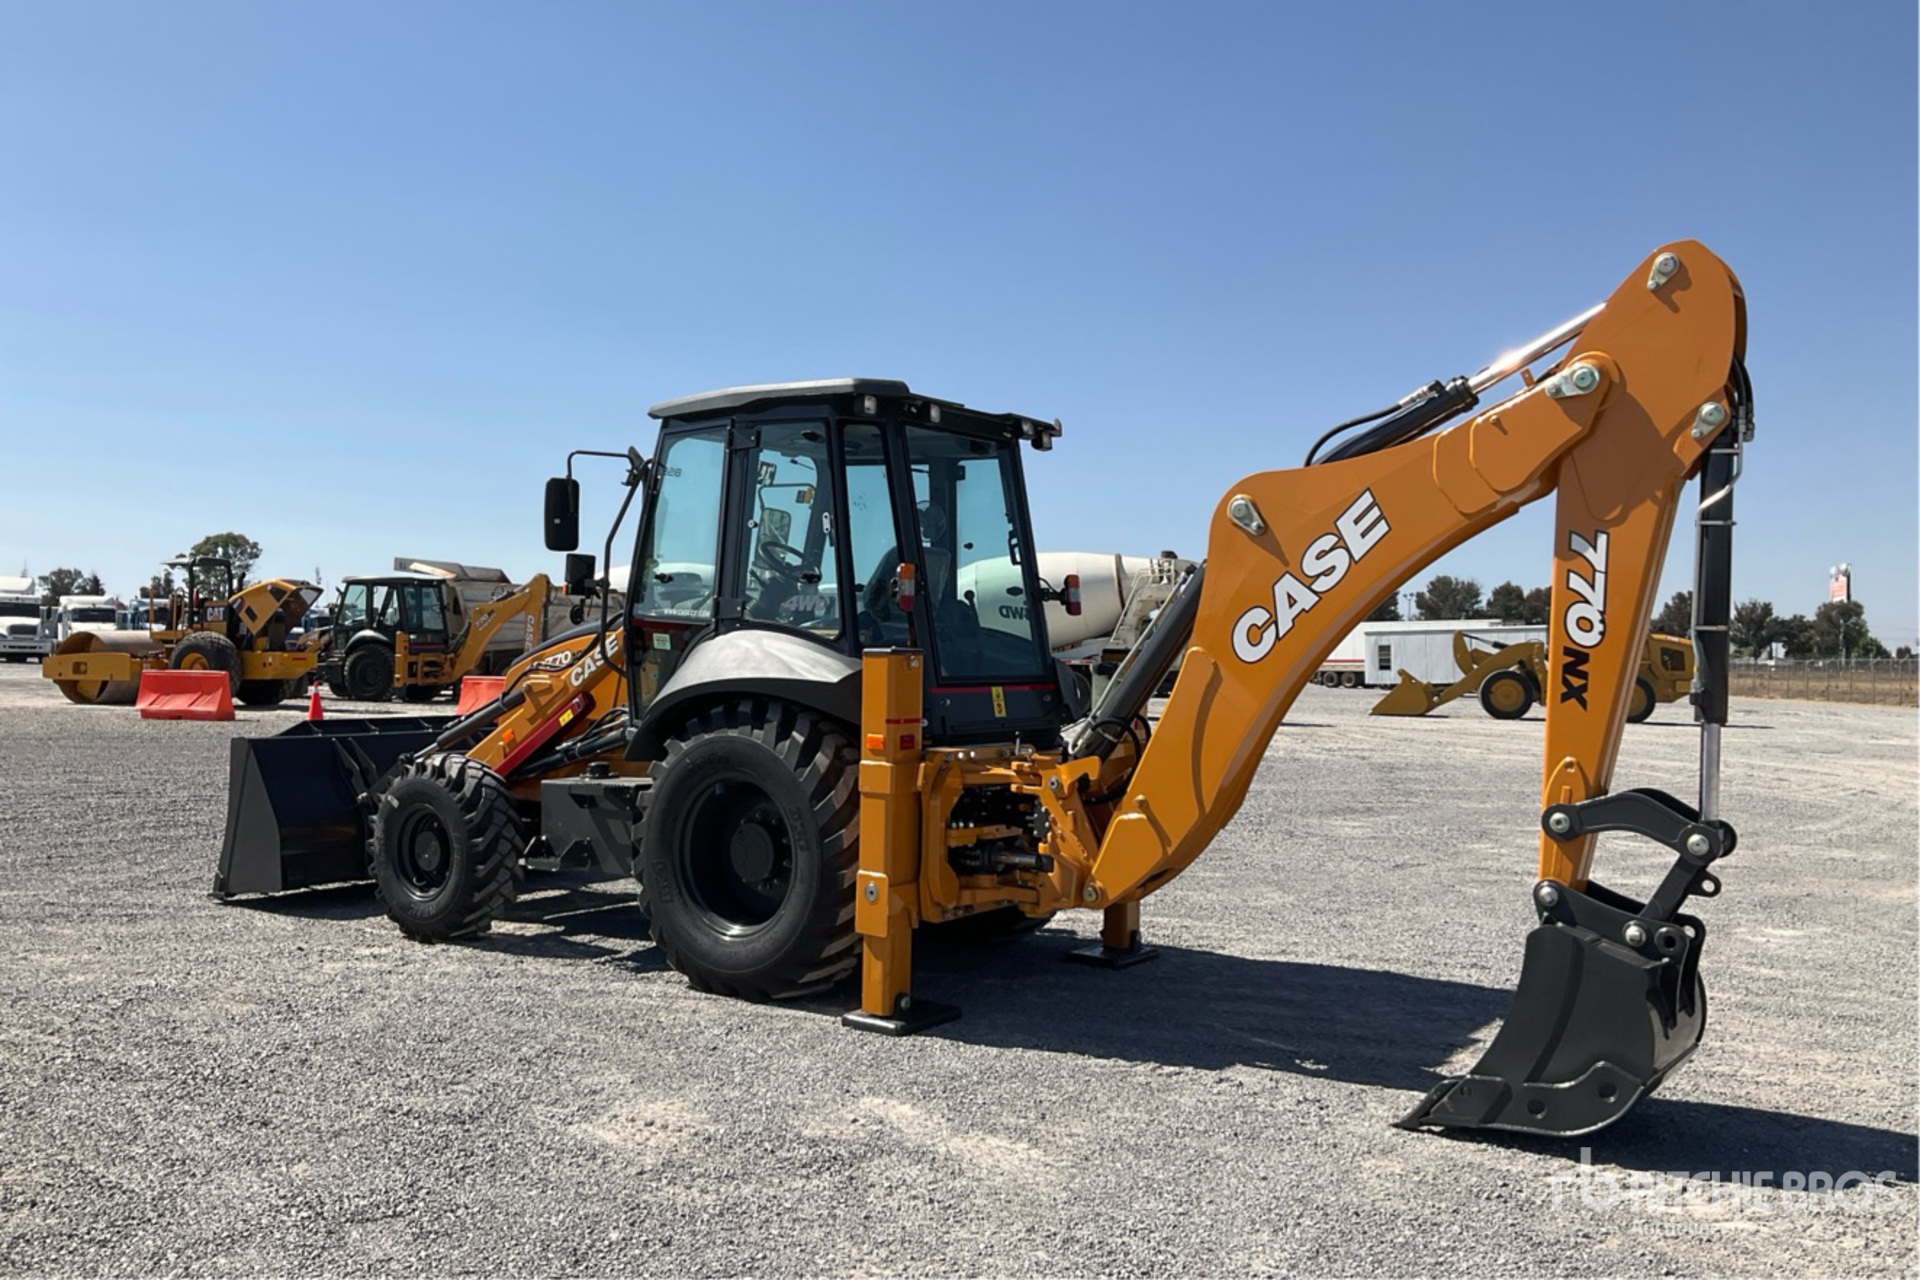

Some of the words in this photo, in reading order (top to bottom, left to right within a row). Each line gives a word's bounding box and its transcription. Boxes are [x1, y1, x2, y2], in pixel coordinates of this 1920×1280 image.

[1231, 487, 1392, 664] CASE
[1564, 529, 1610, 649] 770
[206, 606, 225, 621] CAT
[524, 615, 535, 650] CASE
[569, 633, 620, 687] CASE
[1560, 646, 1590, 711] NX
